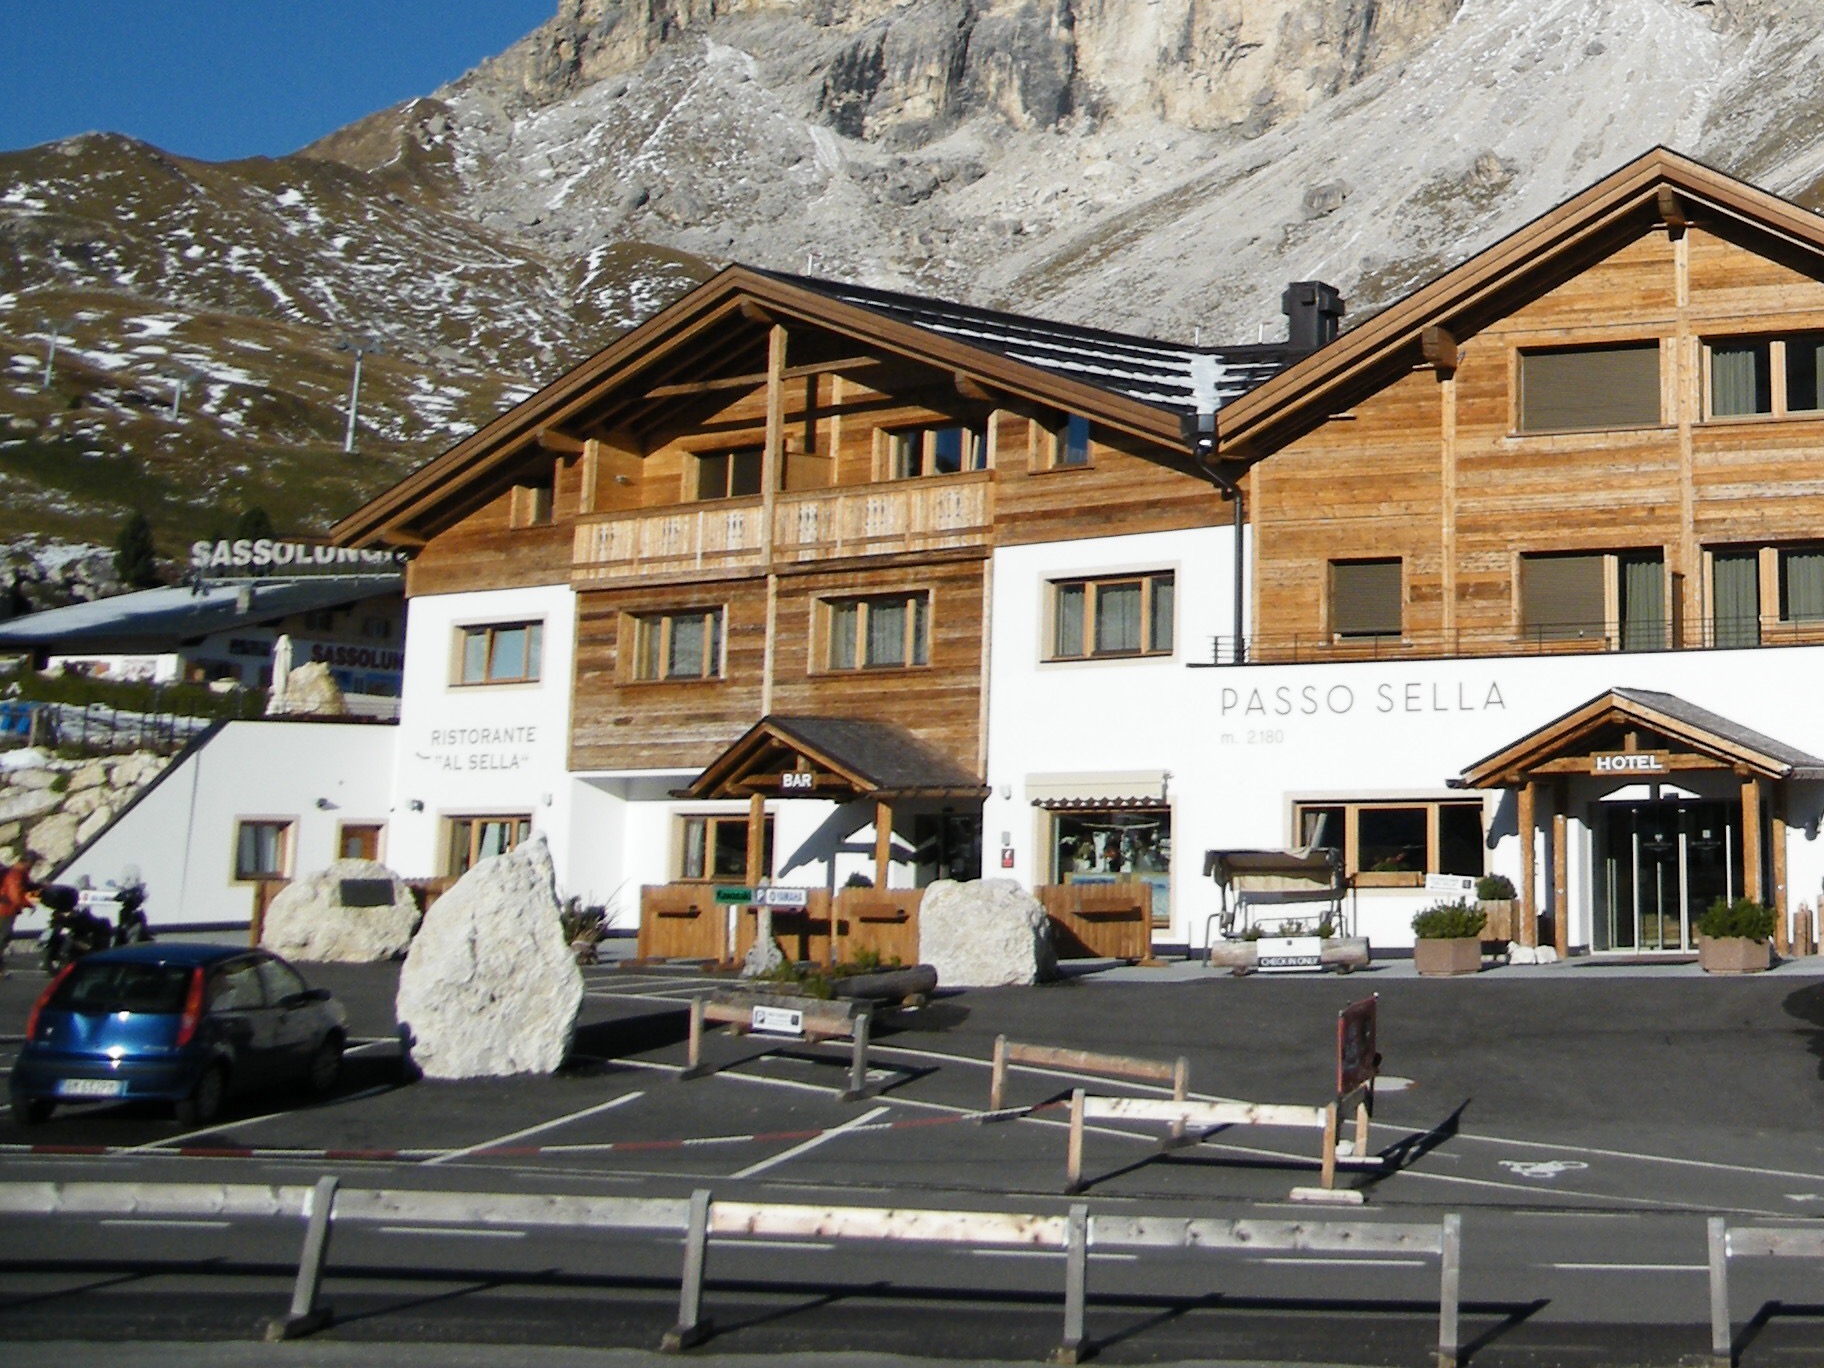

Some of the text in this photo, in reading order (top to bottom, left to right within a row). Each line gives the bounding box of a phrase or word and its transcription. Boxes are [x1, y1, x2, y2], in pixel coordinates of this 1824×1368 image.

[1221, 680, 1507, 716] PASSO SELLA
[430, 726, 537, 746] RISTORANTE
[1596, 754, 1664, 771] HOTEL
[782, 773, 813, 788] BAR
